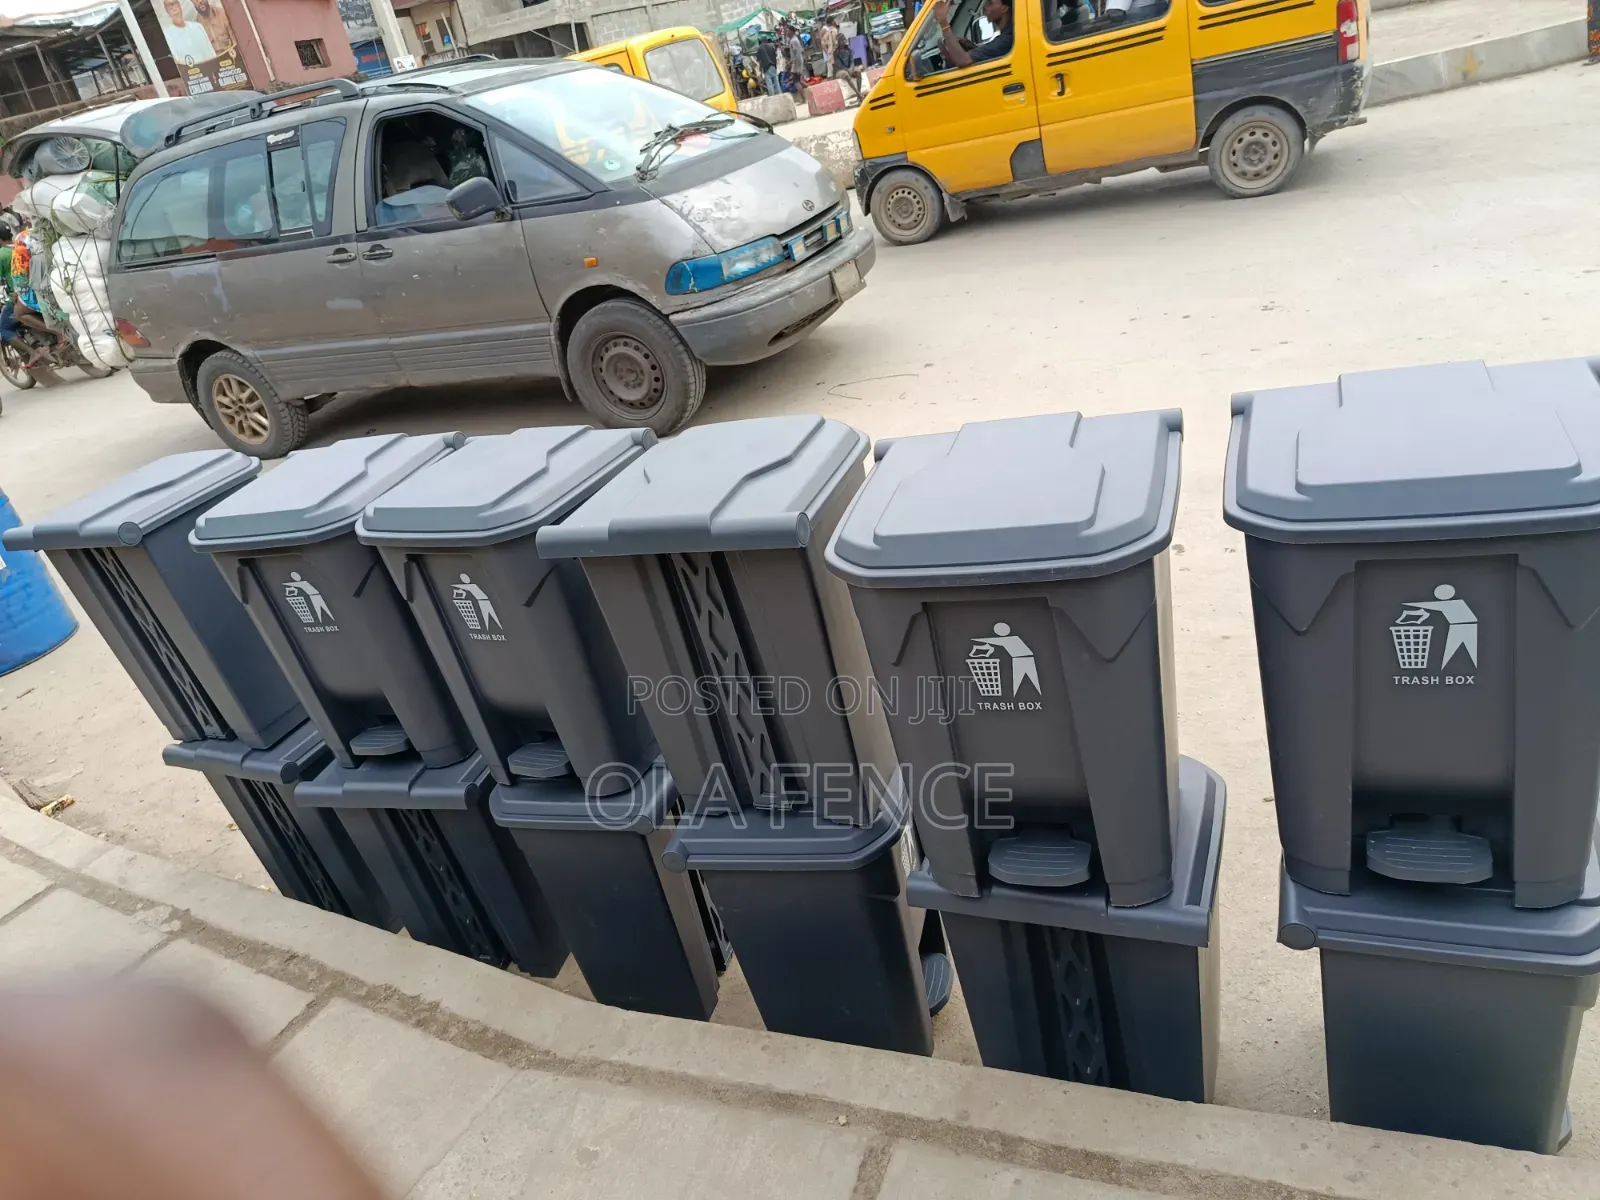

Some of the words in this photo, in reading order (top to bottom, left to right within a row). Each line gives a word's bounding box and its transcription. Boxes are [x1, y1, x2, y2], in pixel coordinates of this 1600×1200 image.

[469, 633, 492, 641] TRASH
[491, 634, 507, 642] BOX
[1392, 675, 1440, 685] TRASH
[1445, 675, 1475, 685] BOX
[976, 702, 1015, 711] TRASH
[1018, 701, 1043, 711] BOX
